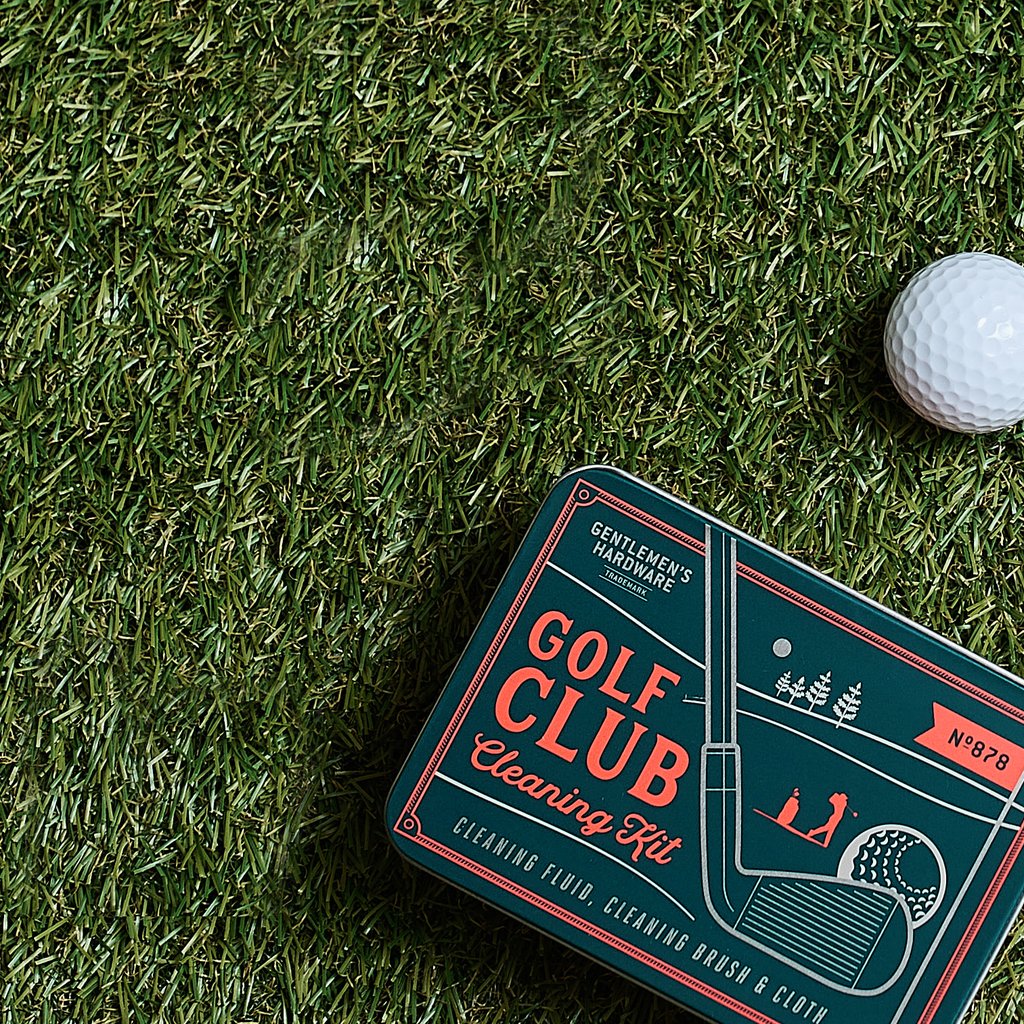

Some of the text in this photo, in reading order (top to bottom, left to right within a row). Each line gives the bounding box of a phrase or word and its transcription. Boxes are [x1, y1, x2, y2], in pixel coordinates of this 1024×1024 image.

[590, 521, 693, 584] GENTLEMEN'S
[592, 540, 675, 593] HARDWARE
[604, 569, 647, 597] TRADEMARK
[528, 610, 682, 714] GOLF
[494, 666, 690, 808] CLUB
[470, 732, 684, 865] Cleaning Kit
[452, 816, 829, 1024] CLEANING FLUID, CLEANING BRUSH & CLOTH
